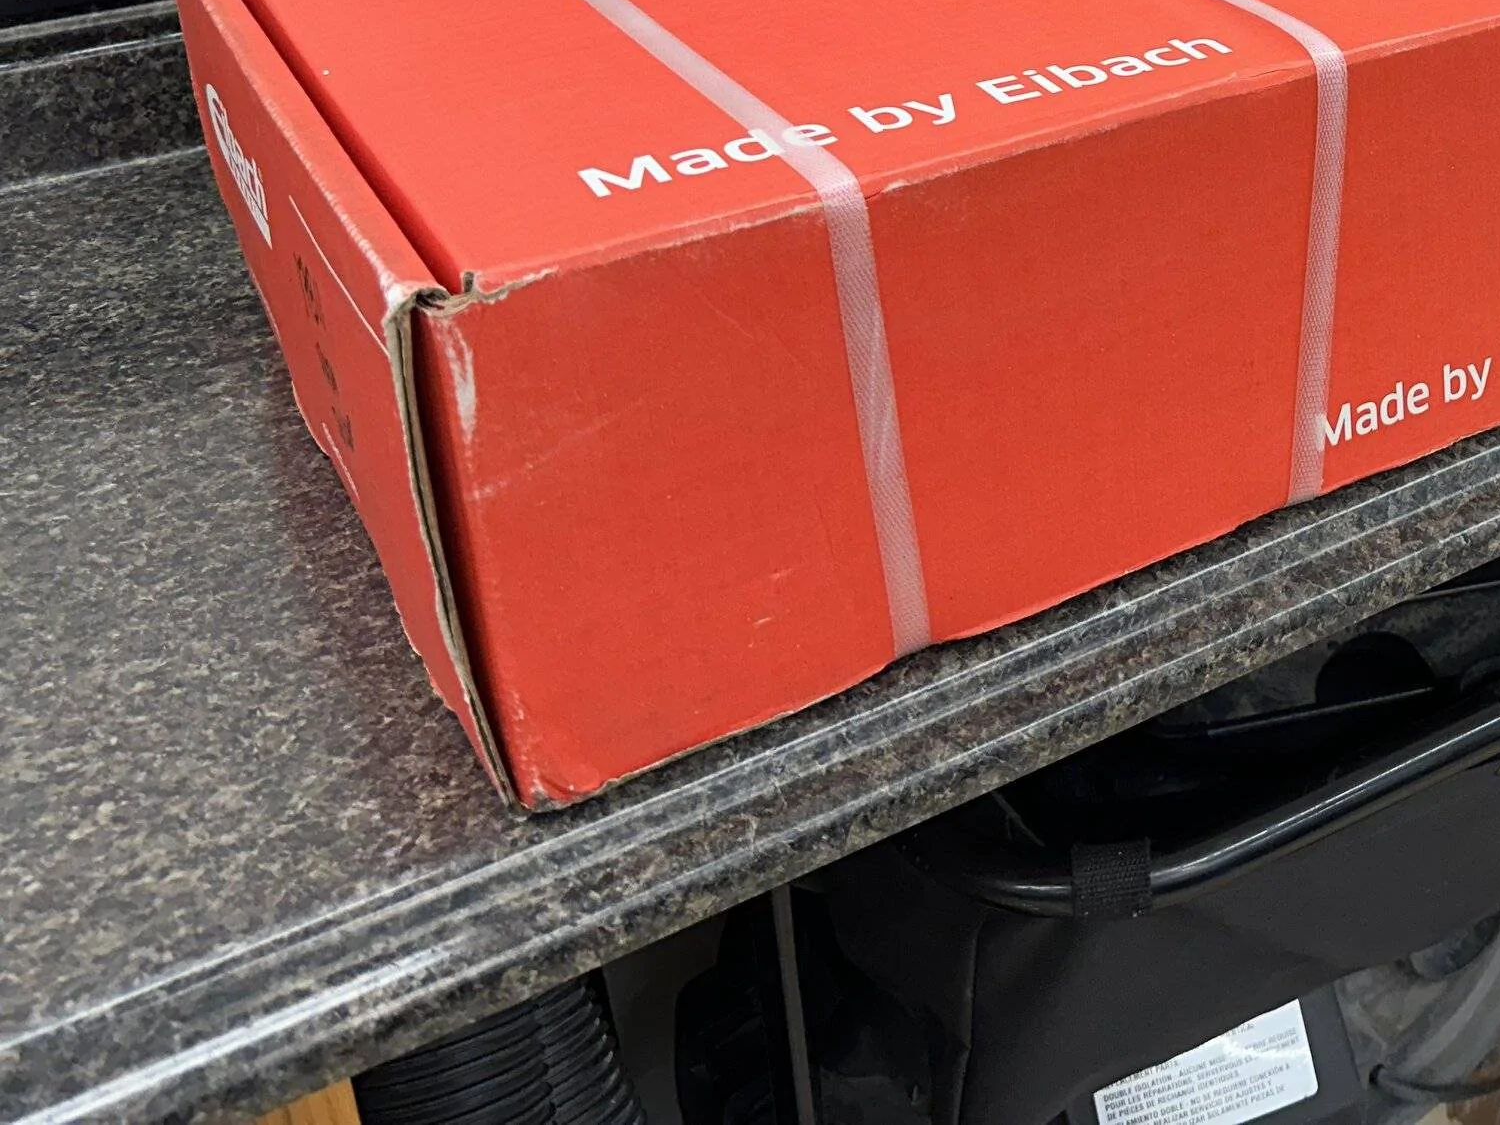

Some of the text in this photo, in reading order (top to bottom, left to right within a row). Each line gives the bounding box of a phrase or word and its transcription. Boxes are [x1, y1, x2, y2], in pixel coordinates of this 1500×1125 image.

[577, 31, 1234, 198] Made by Eibach
[1315, 380, 1430, 452] Made
[1442, 357, 1493, 403] by
